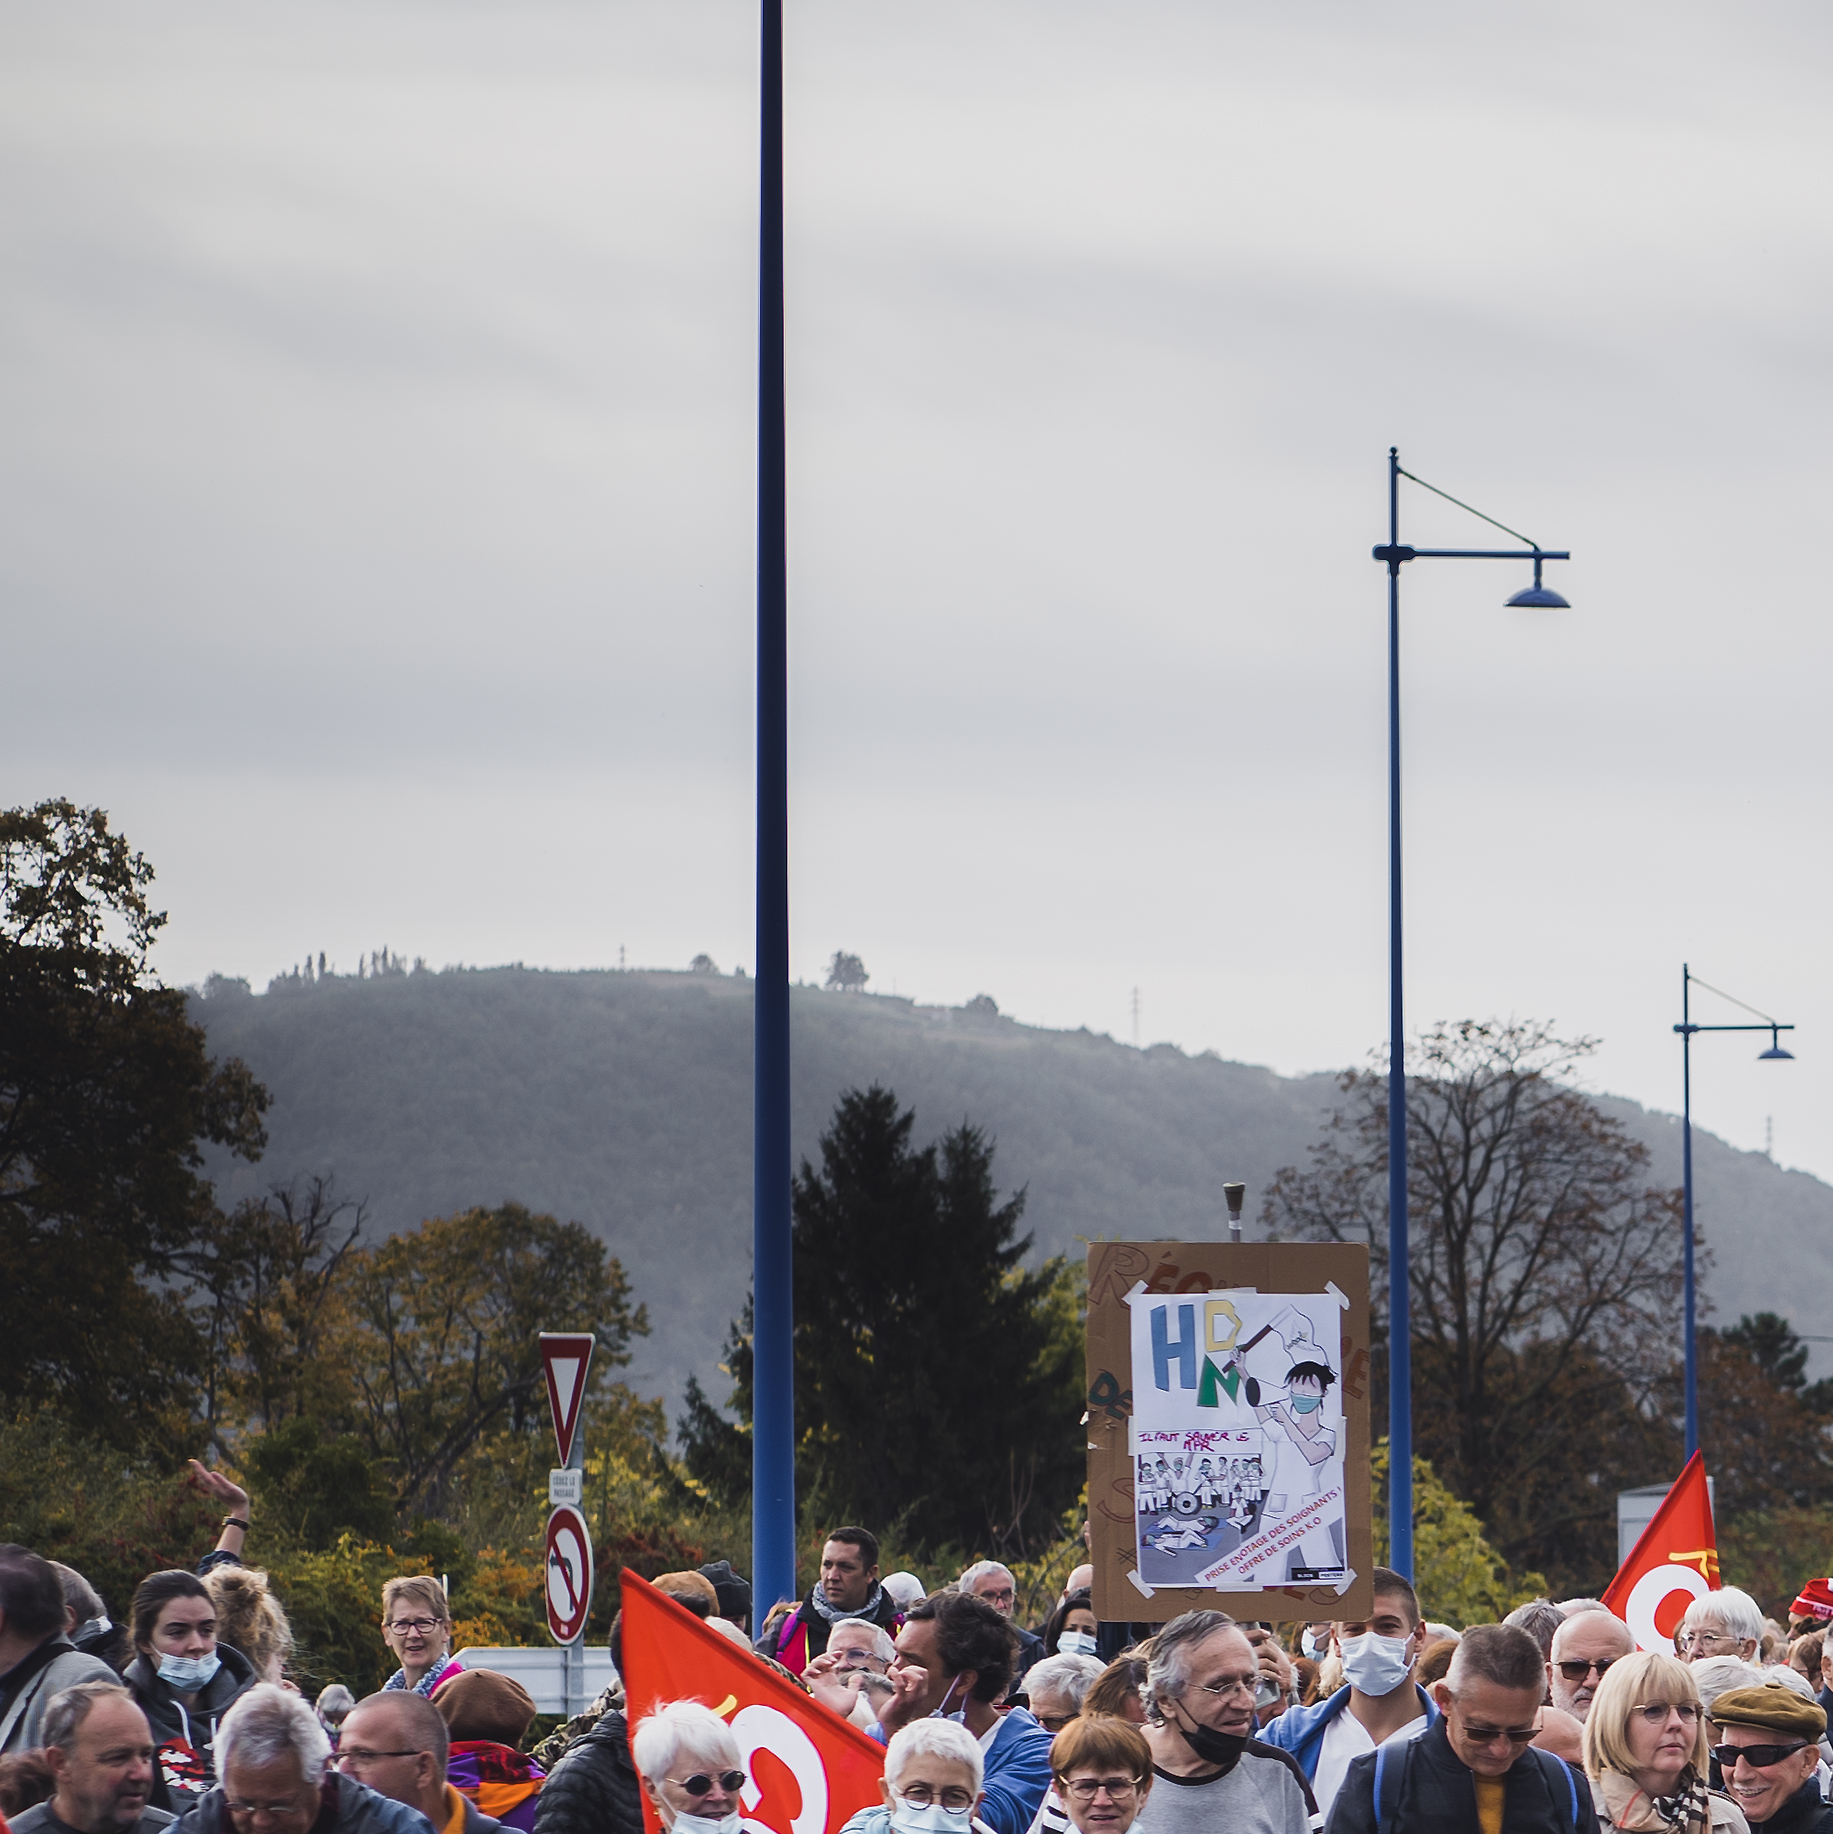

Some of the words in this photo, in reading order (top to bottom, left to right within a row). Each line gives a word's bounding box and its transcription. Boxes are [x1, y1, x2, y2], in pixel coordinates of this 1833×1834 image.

[1154, 1433, 1180, 1442] FAUT
[1186, 1432, 1229, 1442] SAUVER
[569, 1475, 576, 1487] LE
[553, 1488, 575, 1498] PASSAGE
[1205, 1562, 1230, 1582] PRISE
[1268, 1523, 1287, 1540] DES
[1286, 1491, 1338, 1528] SOIGNANTS
[1238, 1552, 1266, 1574] OFFRE
[1266, 1544, 1279, 1557] DE
[1277, 1526, 1306, 1549] SOINS
